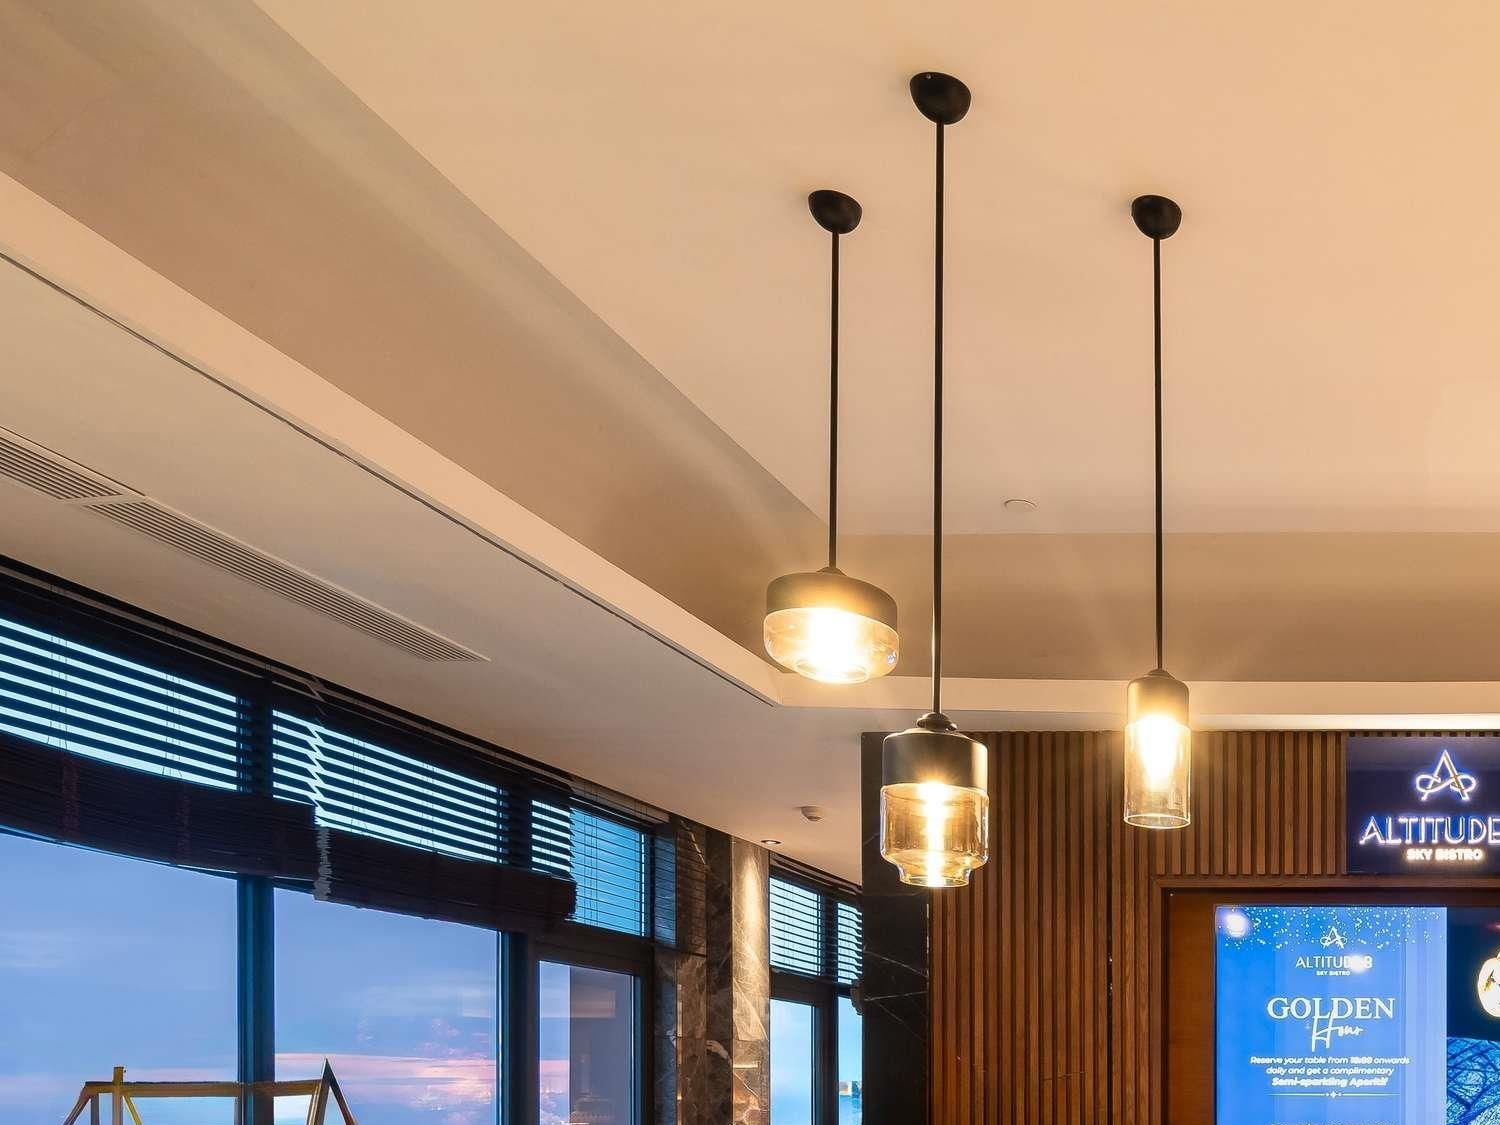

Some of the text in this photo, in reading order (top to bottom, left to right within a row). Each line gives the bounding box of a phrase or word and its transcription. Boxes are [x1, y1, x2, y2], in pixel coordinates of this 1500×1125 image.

[1406, 848, 1483, 861] SKY BISTRO
[1295, 956, 1360, 969] ALTITUD
[1266, 997, 1396, 1020] GOLDEN
[1311, 1009, 1363, 1052] Hour
[1250, 1056, 1283, 1064] Reserve
[1283, 1057, 1304, 1066] your
[1304, 1056, 1327, 1064] table
[1327, 1056, 1349, 1064] from
[1373, 1056, 1410, 1064] onwards
[1266, 1066, 1288, 1076] daily
[1288, 1066, 1305, 1075] and
[1306, 1067, 1321, 1076] get
[1330, 1066, 1394, 1076] complimentary
[1272, 1077, 1348, 1087] Semi-sparkling
